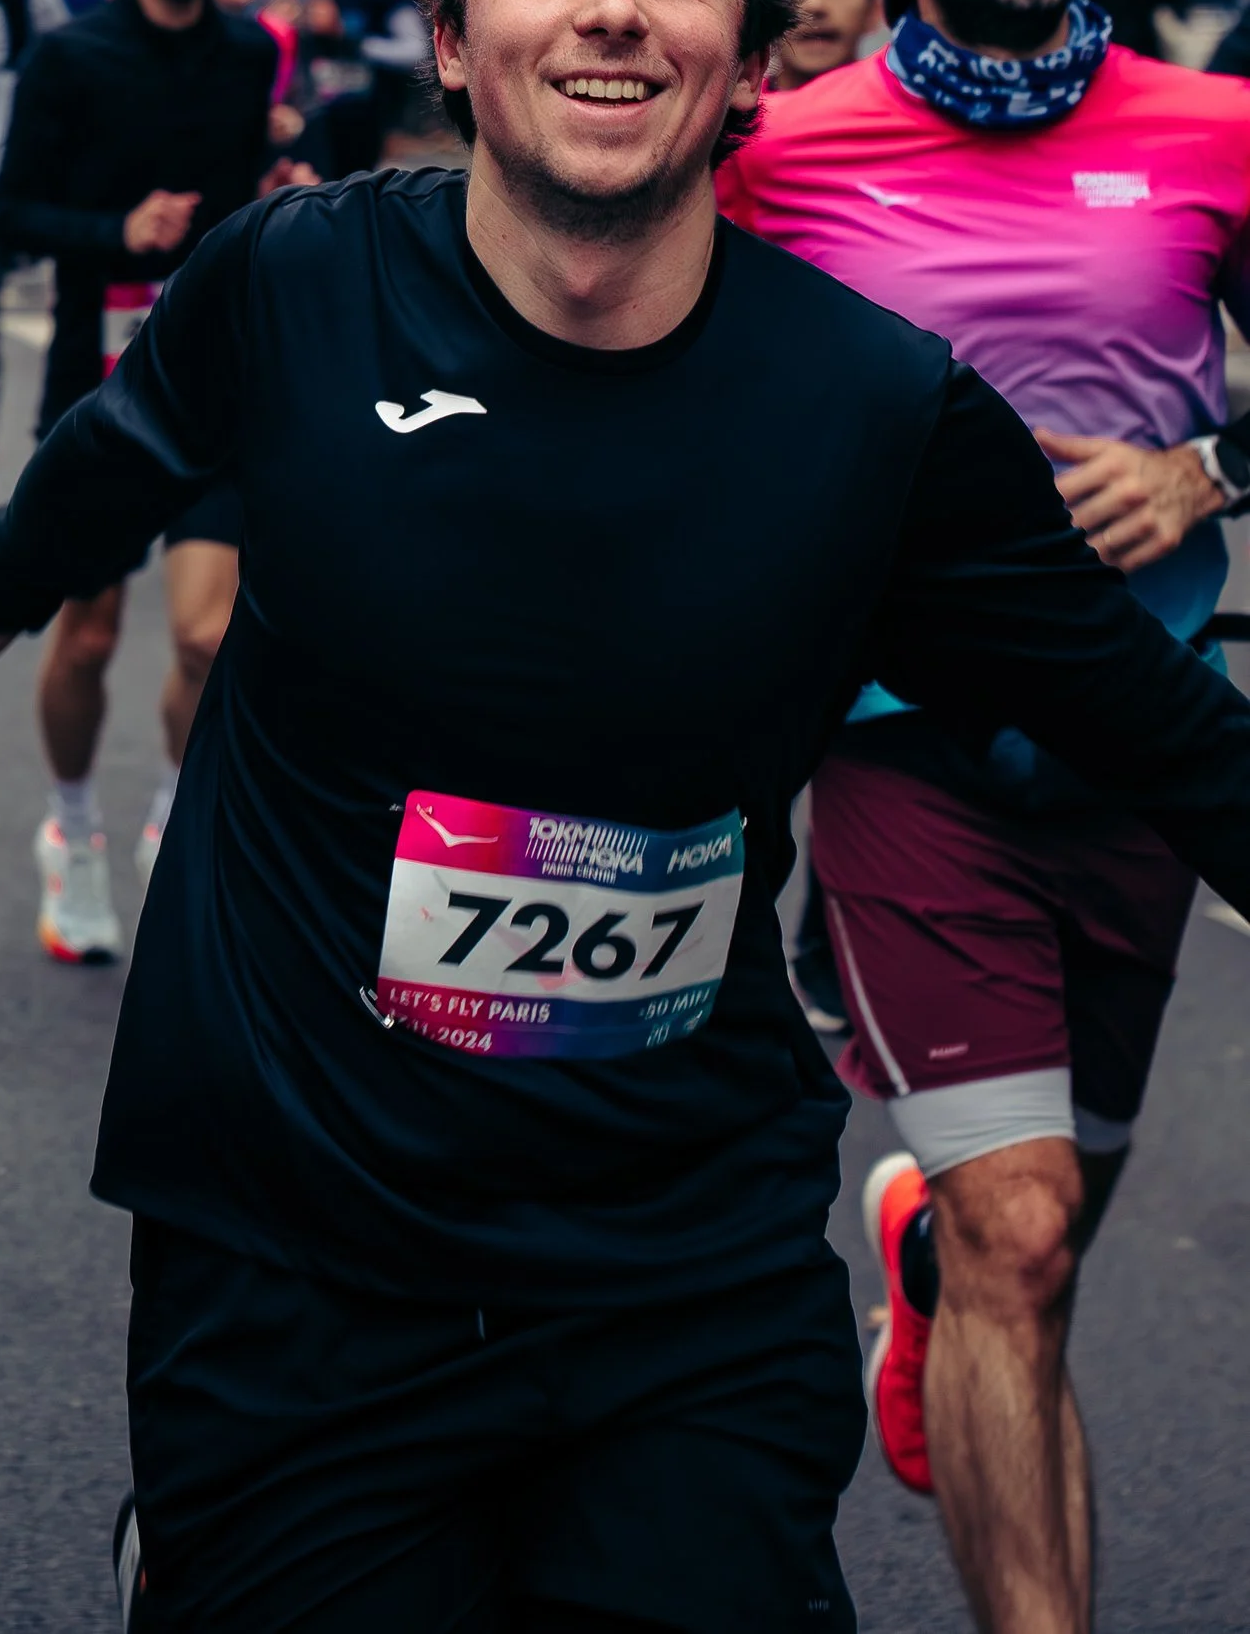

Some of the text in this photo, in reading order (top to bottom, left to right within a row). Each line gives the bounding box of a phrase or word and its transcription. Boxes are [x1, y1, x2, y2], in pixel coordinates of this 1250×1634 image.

[667, 832, 733, 874] HOKA
[437, 891, 705, 979] 7267
[389, 987, 551, 1023] LET'S FLY PARIS
